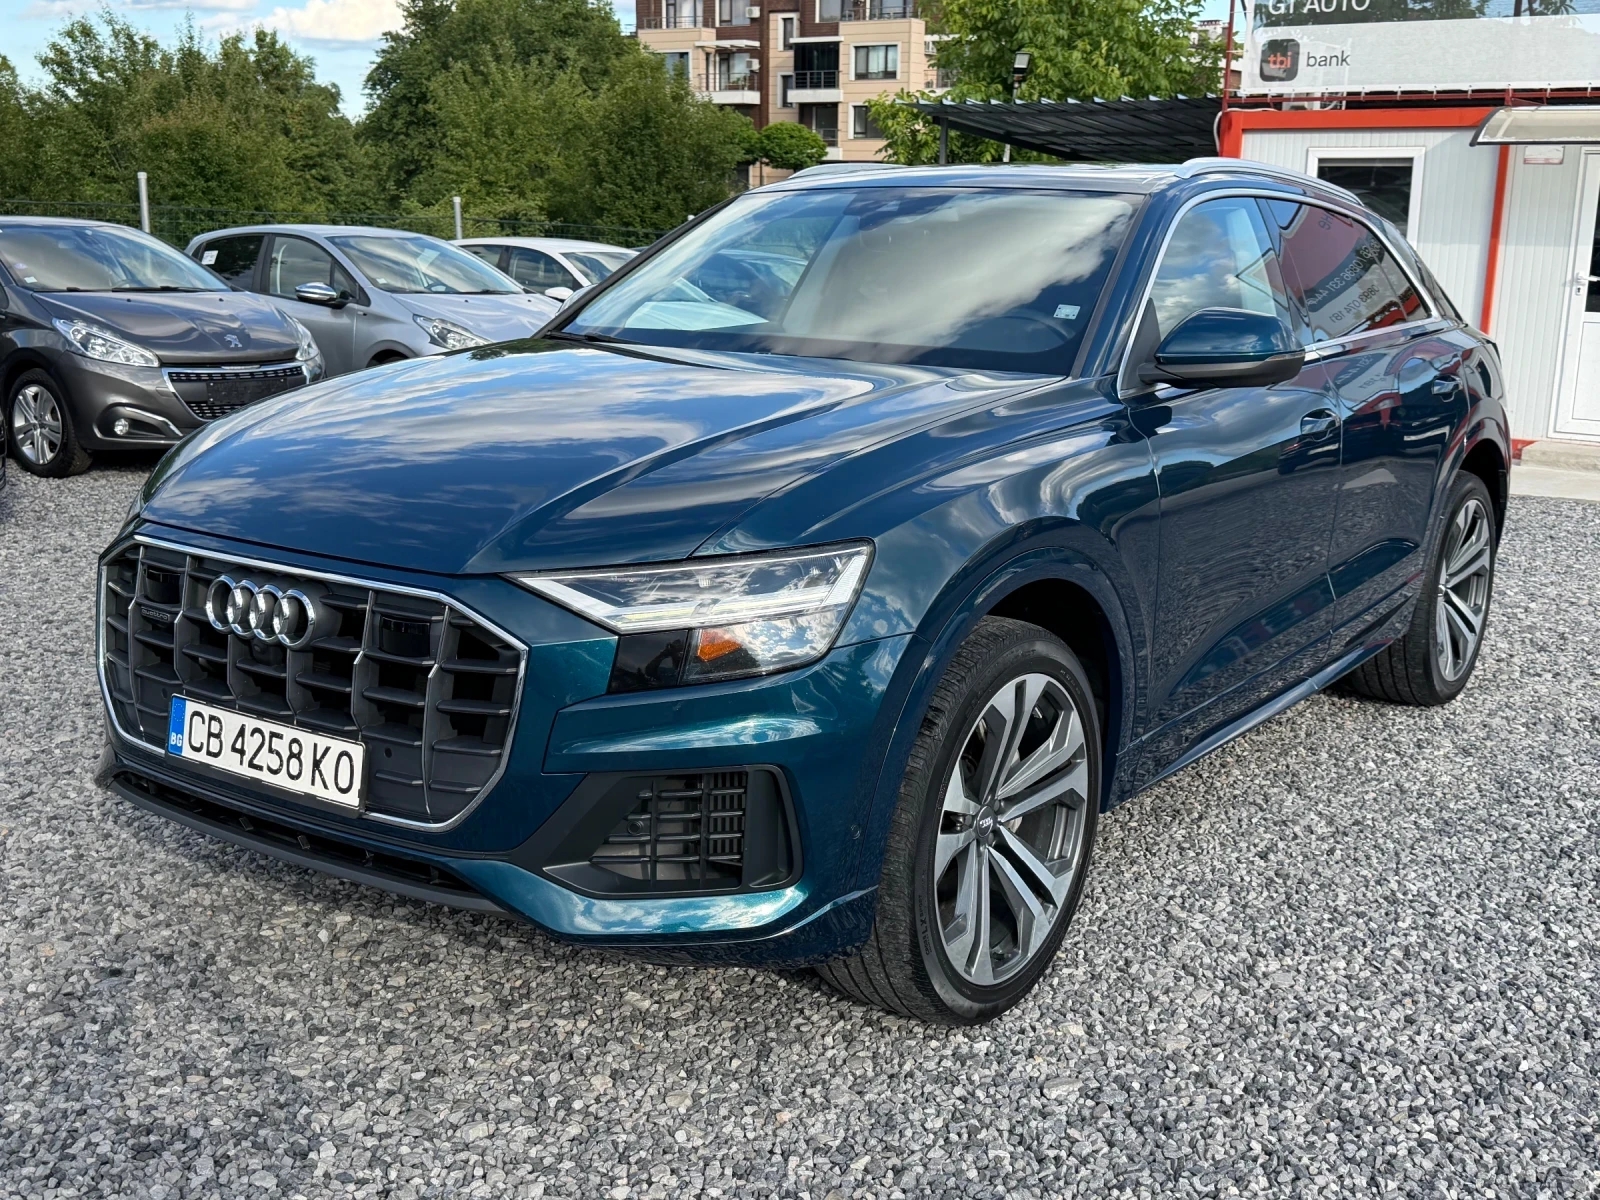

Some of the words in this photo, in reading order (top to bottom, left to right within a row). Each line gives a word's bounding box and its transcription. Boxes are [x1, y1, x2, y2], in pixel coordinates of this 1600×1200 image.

[1268, 52, 1292, 69] tbi
[1306, 50, 1350, 67] bank
[170, 732, 183, 747] BG
[188, 710, 224, 759] CB
[230, 723, 304, 781] 4258
[310, 742, 355, 795] KO
